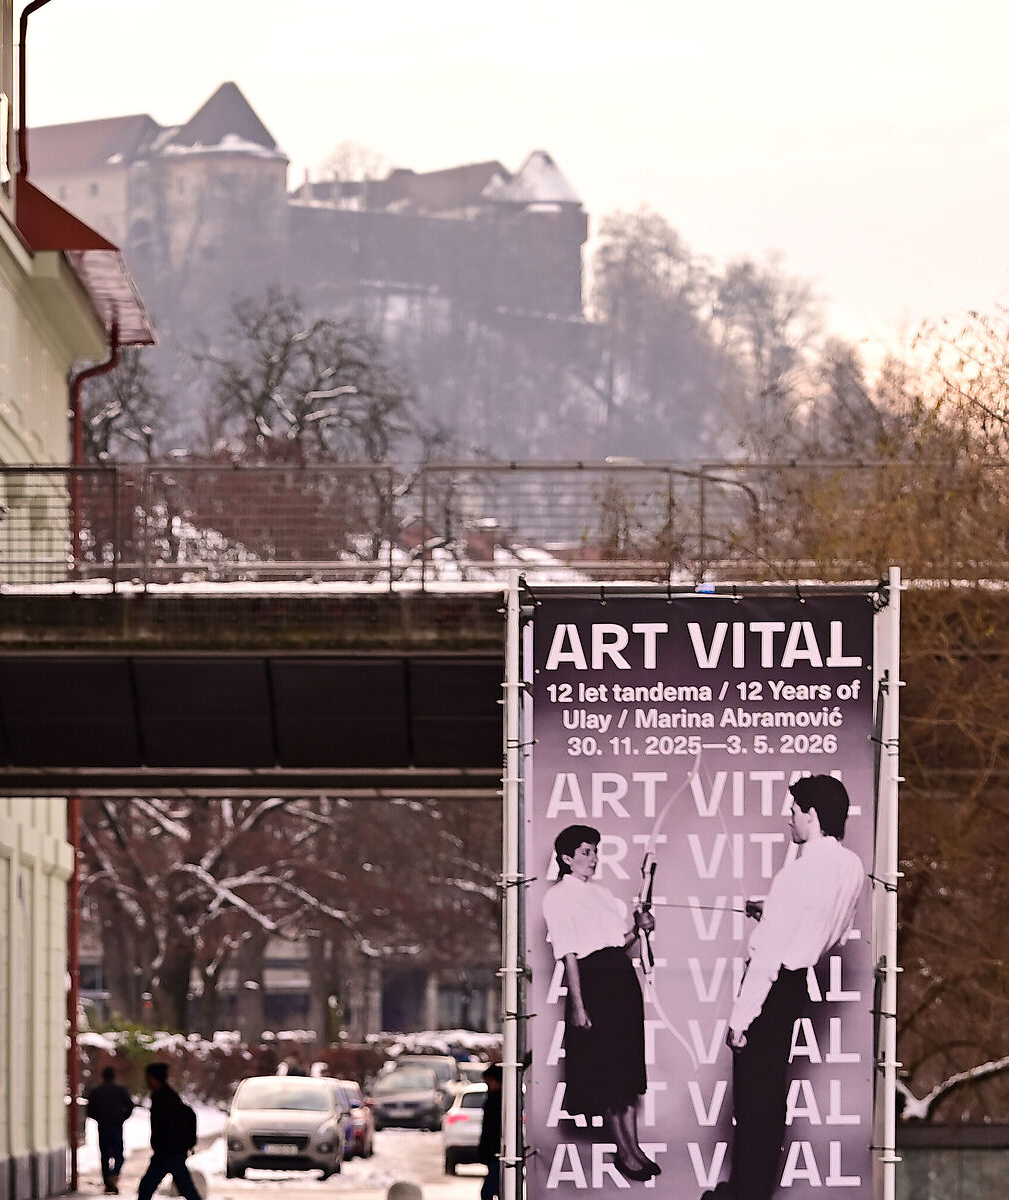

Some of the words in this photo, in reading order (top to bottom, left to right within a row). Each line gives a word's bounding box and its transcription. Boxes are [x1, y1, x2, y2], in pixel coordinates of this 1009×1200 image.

[545, 622, 669, 671] ART
[687, 620, 863, 669] VITAL
[546, 683, 573, 703] 12
[578, 682, 609, 702] let
[612, 681, 713, 702] tandema
[718, 681, 729, 701] /
[736, 681, 764, 701] 12
[767, 680, 832, 701] Years
[836, 679, 862, 701] of
[561, 709, 613, 734] Ulay
[617, 708, 629, 730] /
[634, 708, 715, 729] Marina
[719, 706, 844, 729] Abramović
[566, 736, 603, 756] 30.
[608, 736, 640, 756] 11.
[753, 734, 775, 755] 5.
[779, 734, 839, 755] 2026
[545, 771, 669, 819] ART
[687, 769, 862, 817] VIT
[545, 833, 668, 880] RT
[687, 1017, 862, 1064] VAL
[687, 1079, 862, 1126] VAL
[546, 1142, 668, 1189] ART
[687, 1141, 862, 1188] VAL
